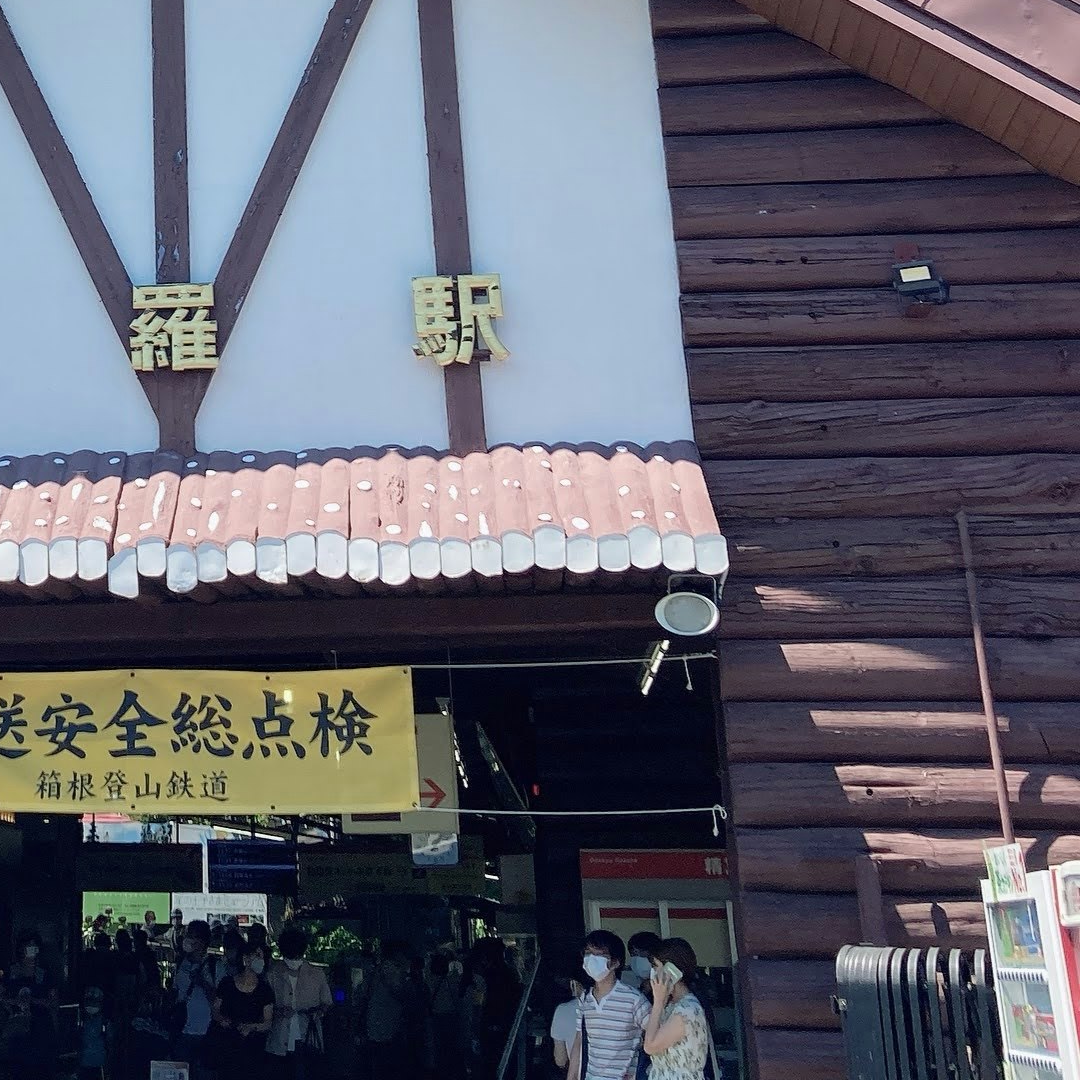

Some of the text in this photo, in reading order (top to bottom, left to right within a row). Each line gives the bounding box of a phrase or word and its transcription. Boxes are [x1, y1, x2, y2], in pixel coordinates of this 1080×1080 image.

[34, 770, 230, 802] 箱根登山鉄道
